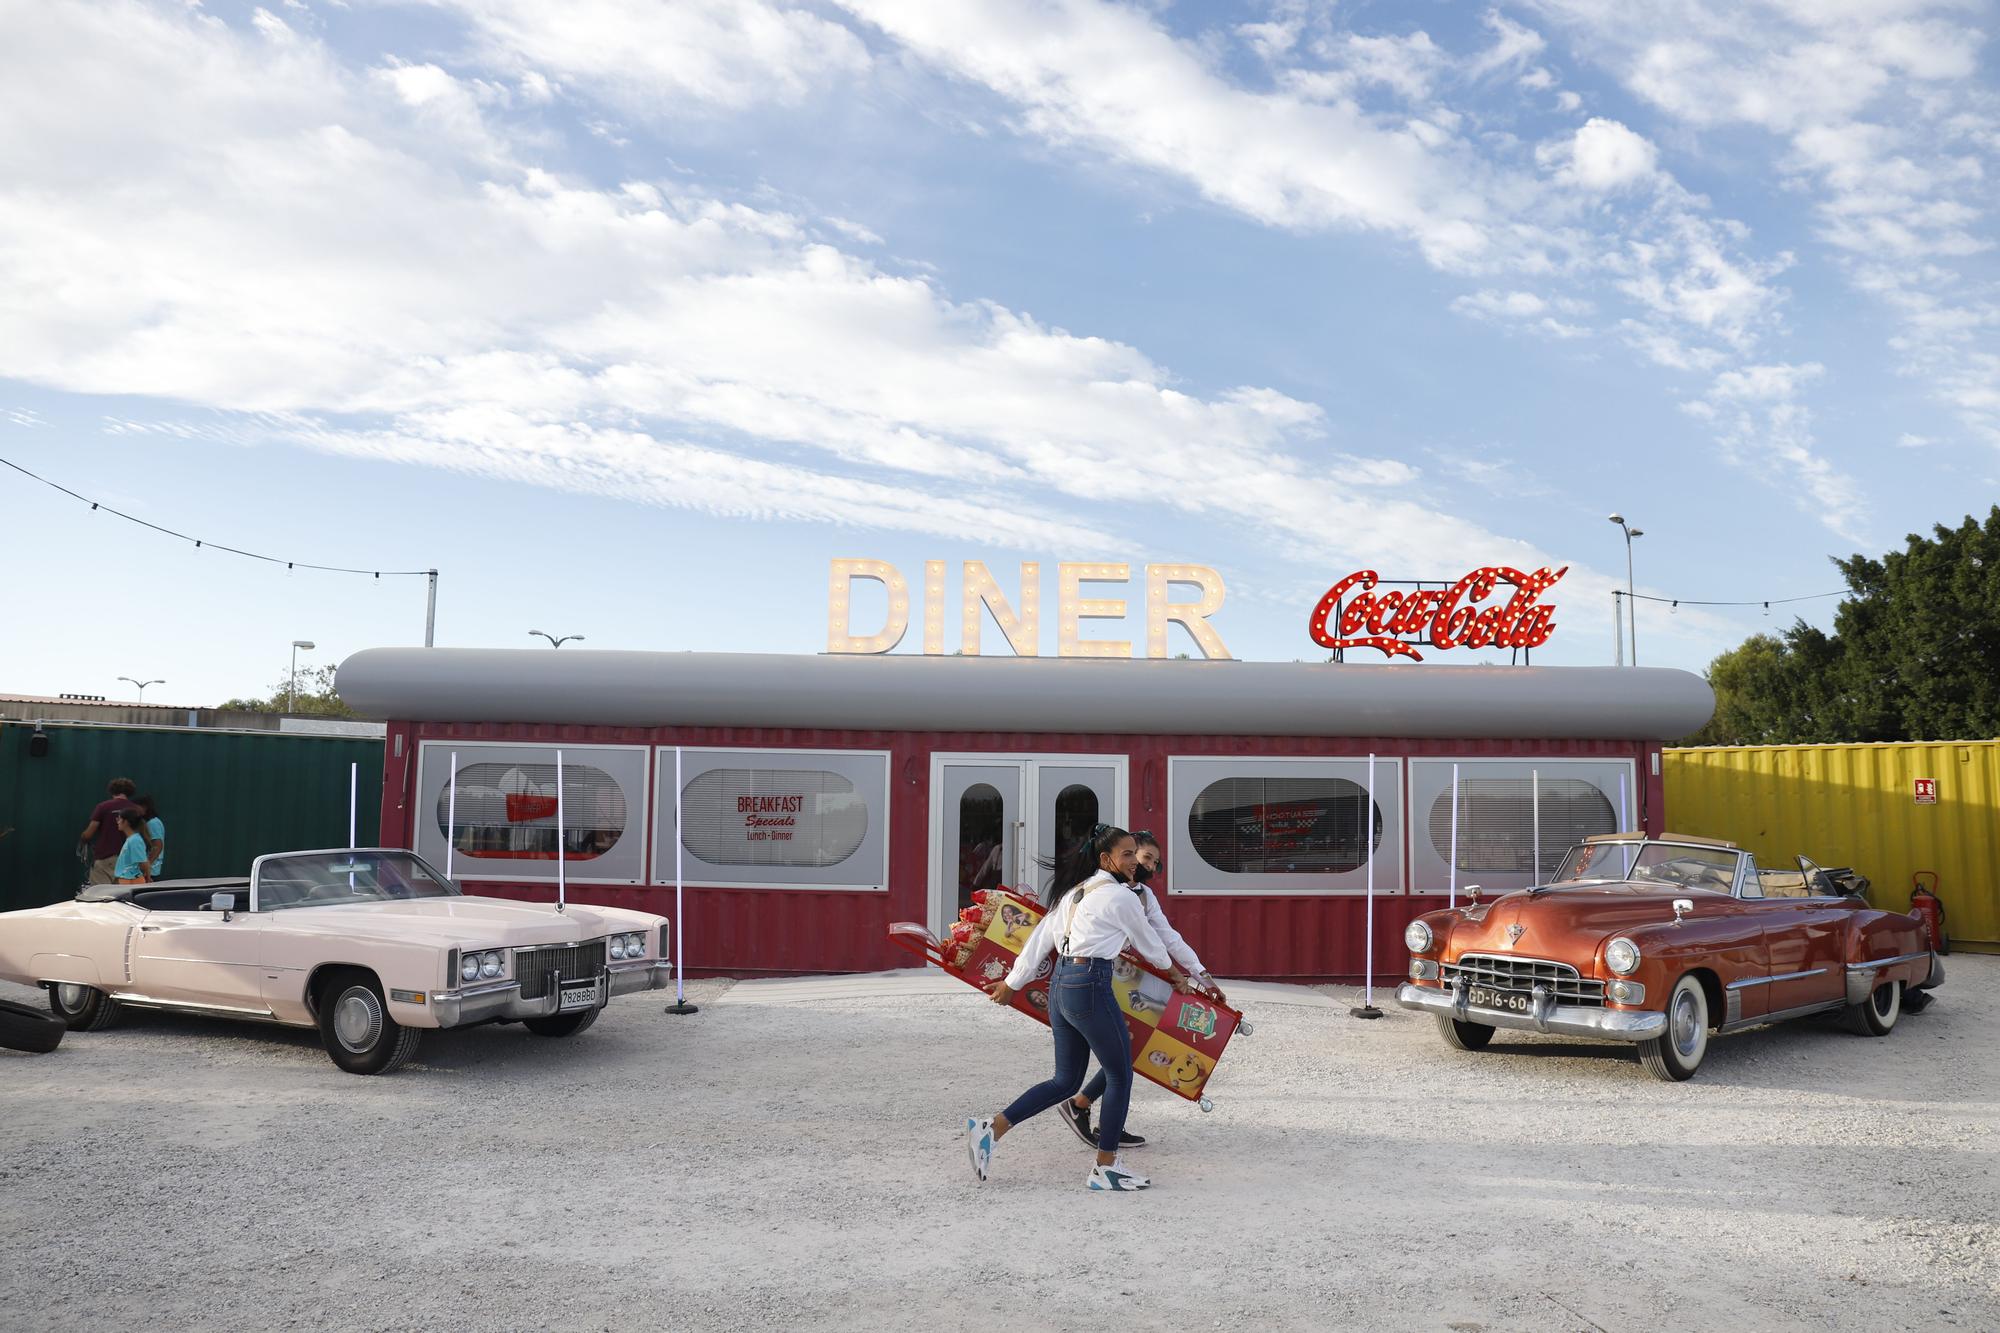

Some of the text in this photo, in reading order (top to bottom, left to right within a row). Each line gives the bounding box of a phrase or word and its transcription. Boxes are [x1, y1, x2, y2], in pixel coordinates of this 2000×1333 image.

[827, 558, 1233, 659] DINER
[737, 796, 803, 812] BREAKFAST
[745, 814, 795, 828] Specials
[747, 830, 767, 840] Lunch
[772, 830, 793, 840] Dinner
[1468, 990, 1527, 1010] GD-16-60
